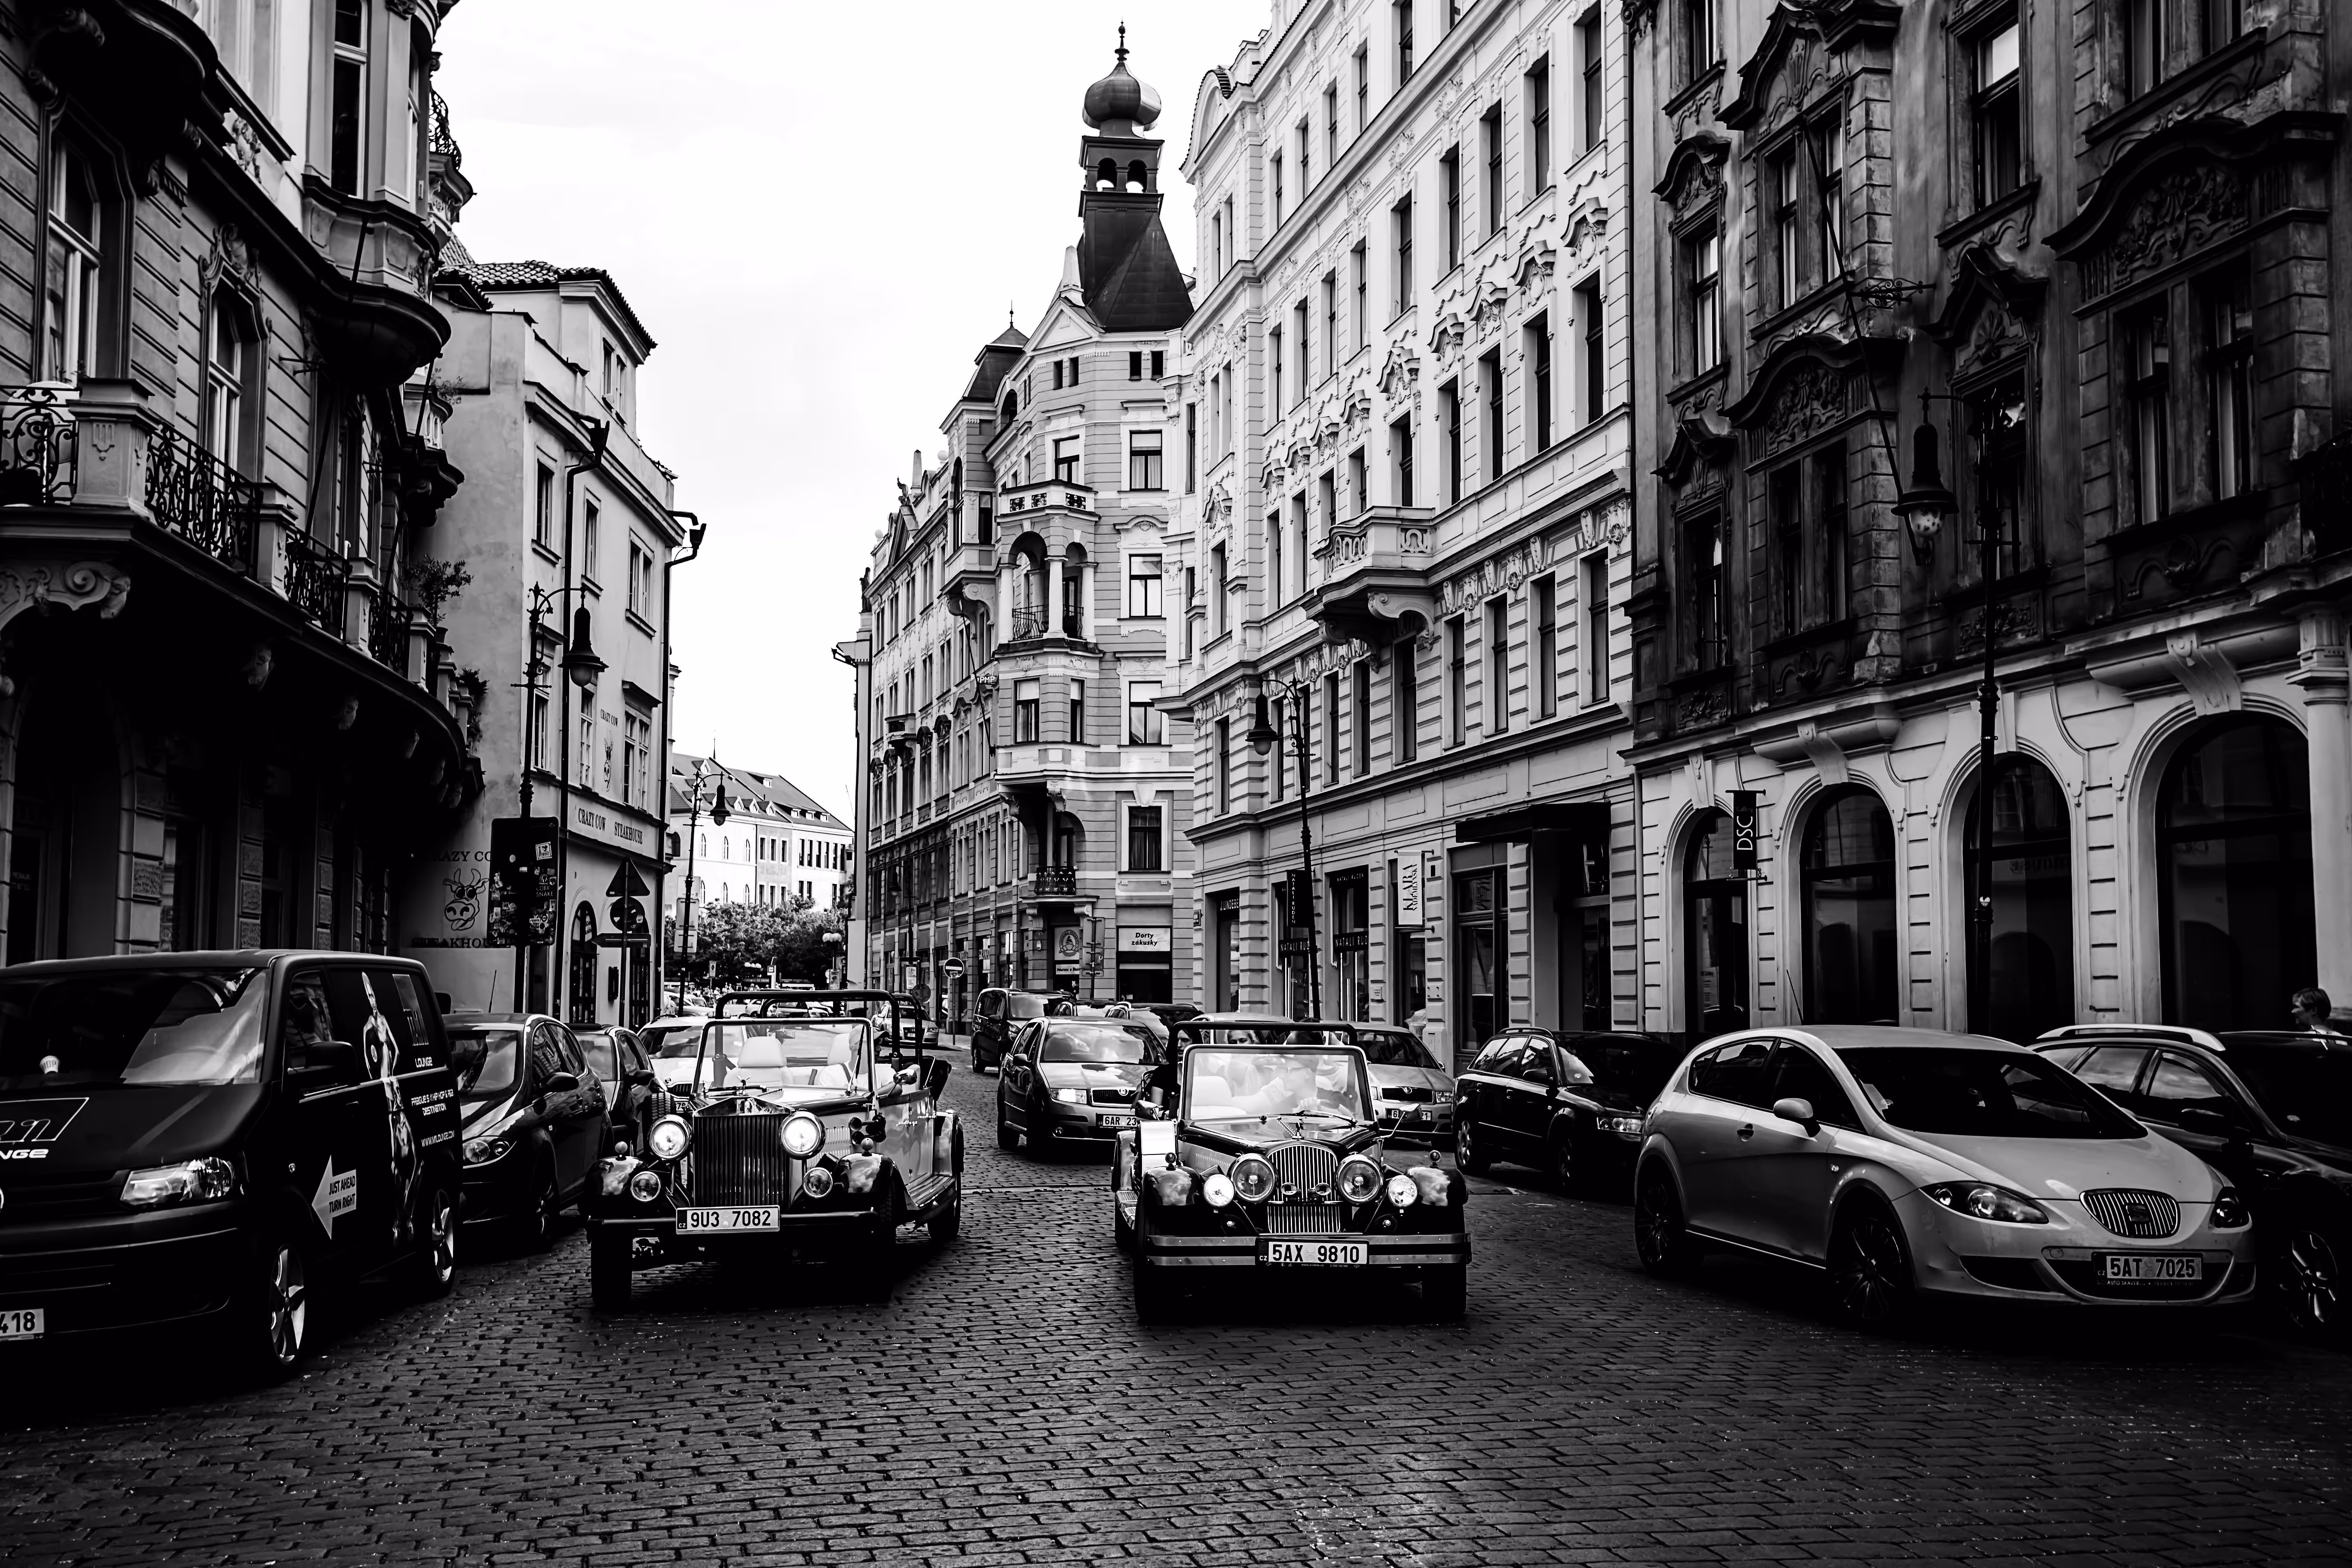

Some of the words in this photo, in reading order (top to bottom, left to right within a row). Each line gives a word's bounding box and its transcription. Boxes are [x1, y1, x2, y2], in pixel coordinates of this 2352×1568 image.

[600, 709, 611, 723] CRAZY
[1736, 806, 1753, 815] Gallery
[578, 808, 595, 827] CRAZY
[595, 814, 606, 831] COW
[614, 821, 643, 844] STEAKHOUSE
[1736, 816, 1753, 851] DSC
[428, 851, 470, 861] RAZY
[1402, 864, 1413, 910] KLARA
[411, 938, 499, 948] STEAKHO
[1280, 943, 1297, 952] NATALI
[1335, 937, 1354, 947] NATALI
[415, 1057, 433, 1068] LOUNGE
[422, 1102, 447, 1116] DESTINATION
[1105, 1116, 1120, 1125] 6AR
[1127, 1117, 1136, 1126] 23
[329, 1180, 340, 1195] JUST
[341, 1176, 355, 1191] AHEAD
[329, 1198, 342, 1213] TURN
[343, 1193, 355, 1209] RIGHT
[691, 1211, 720, 1228] 9U3
[732, 1210, 771, 1227] 7082
[1273, 1244, 1304, 1262] 5AX
[1317, 1245, 1359, 1263] 9810
[2110, 1258, 2142, 1277] 5AT
[2156, 1259, 2195, 1277] 7025
